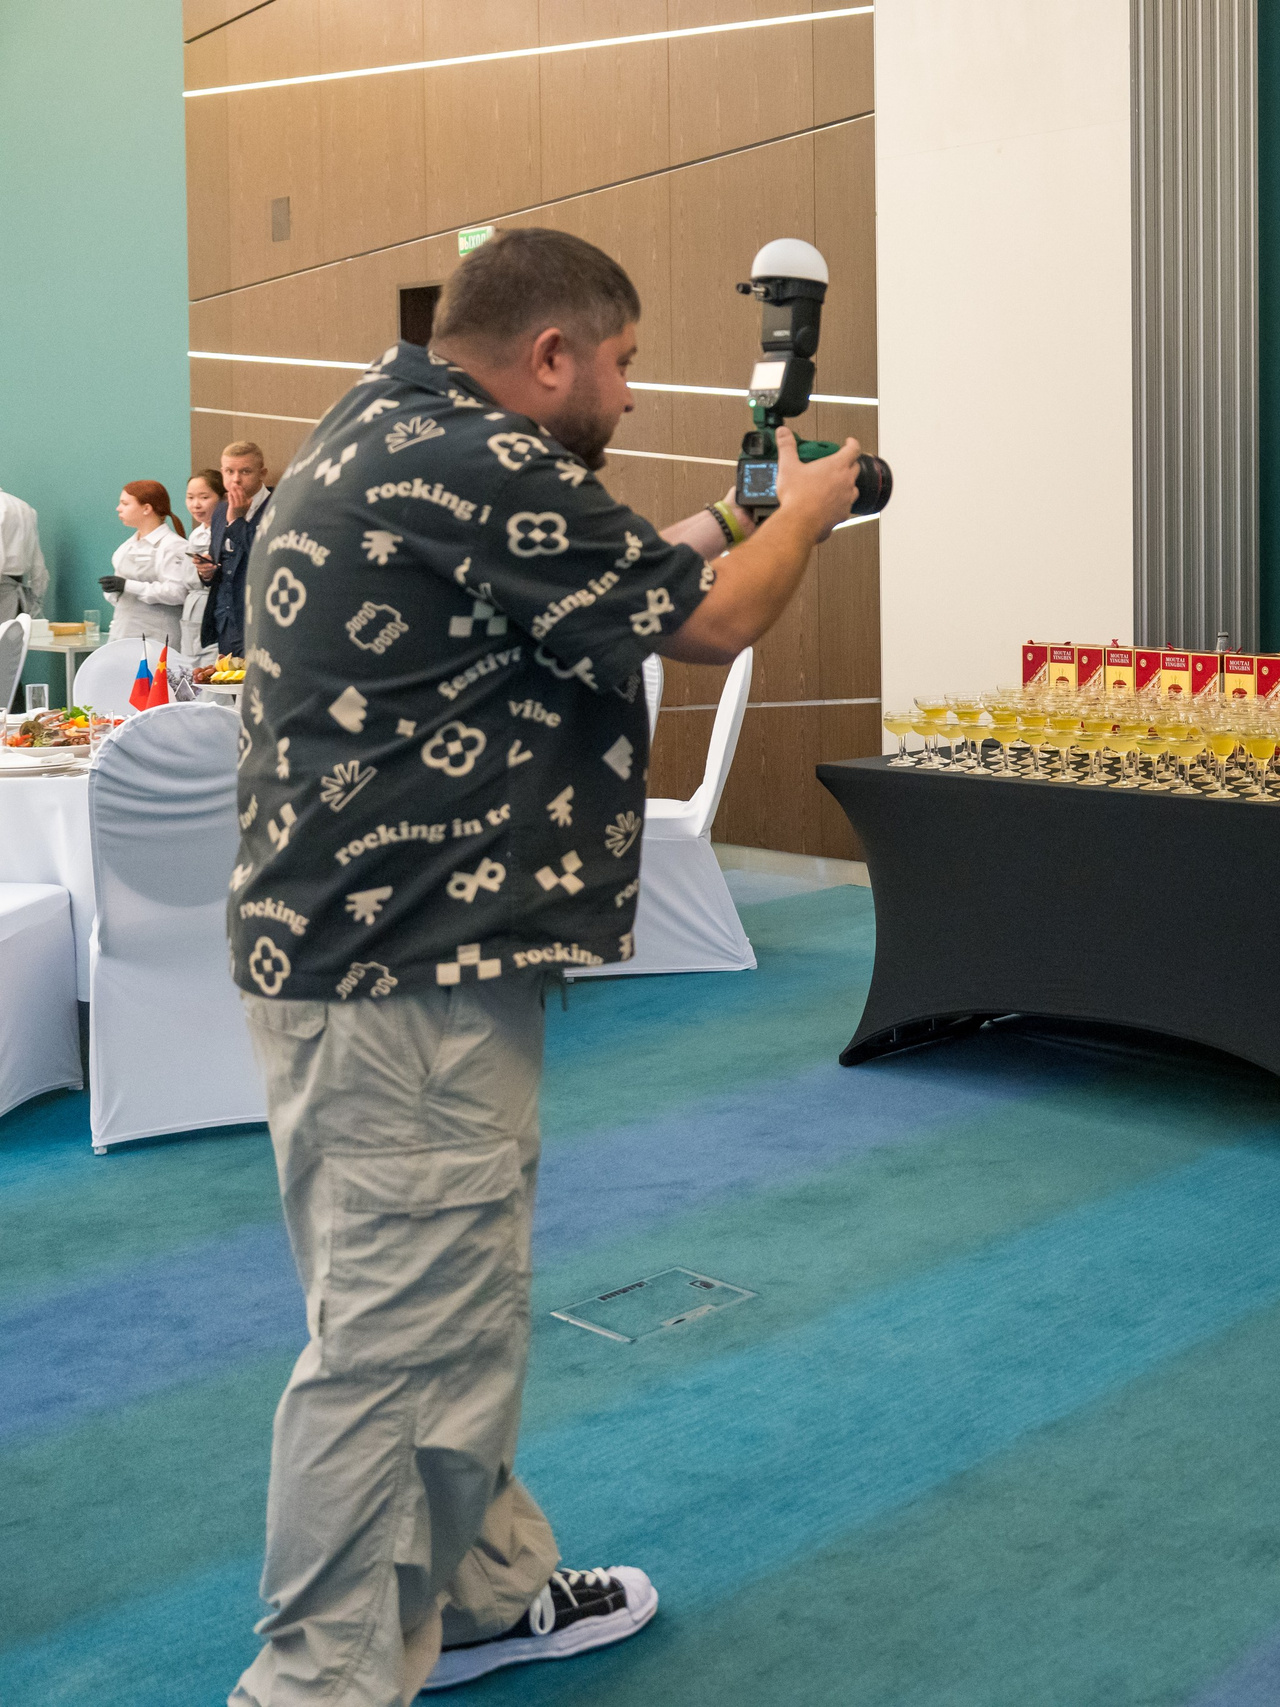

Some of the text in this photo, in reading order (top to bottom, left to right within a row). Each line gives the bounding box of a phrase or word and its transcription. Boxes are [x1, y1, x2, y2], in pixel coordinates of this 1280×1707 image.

[365, 478, 477, 521] rocking
[508, 699, 562, 728] vibe
[334, 820, 447, 867] rocking
[452, 817, 483, 838] in
[240, 897, 310, 936] rocking
